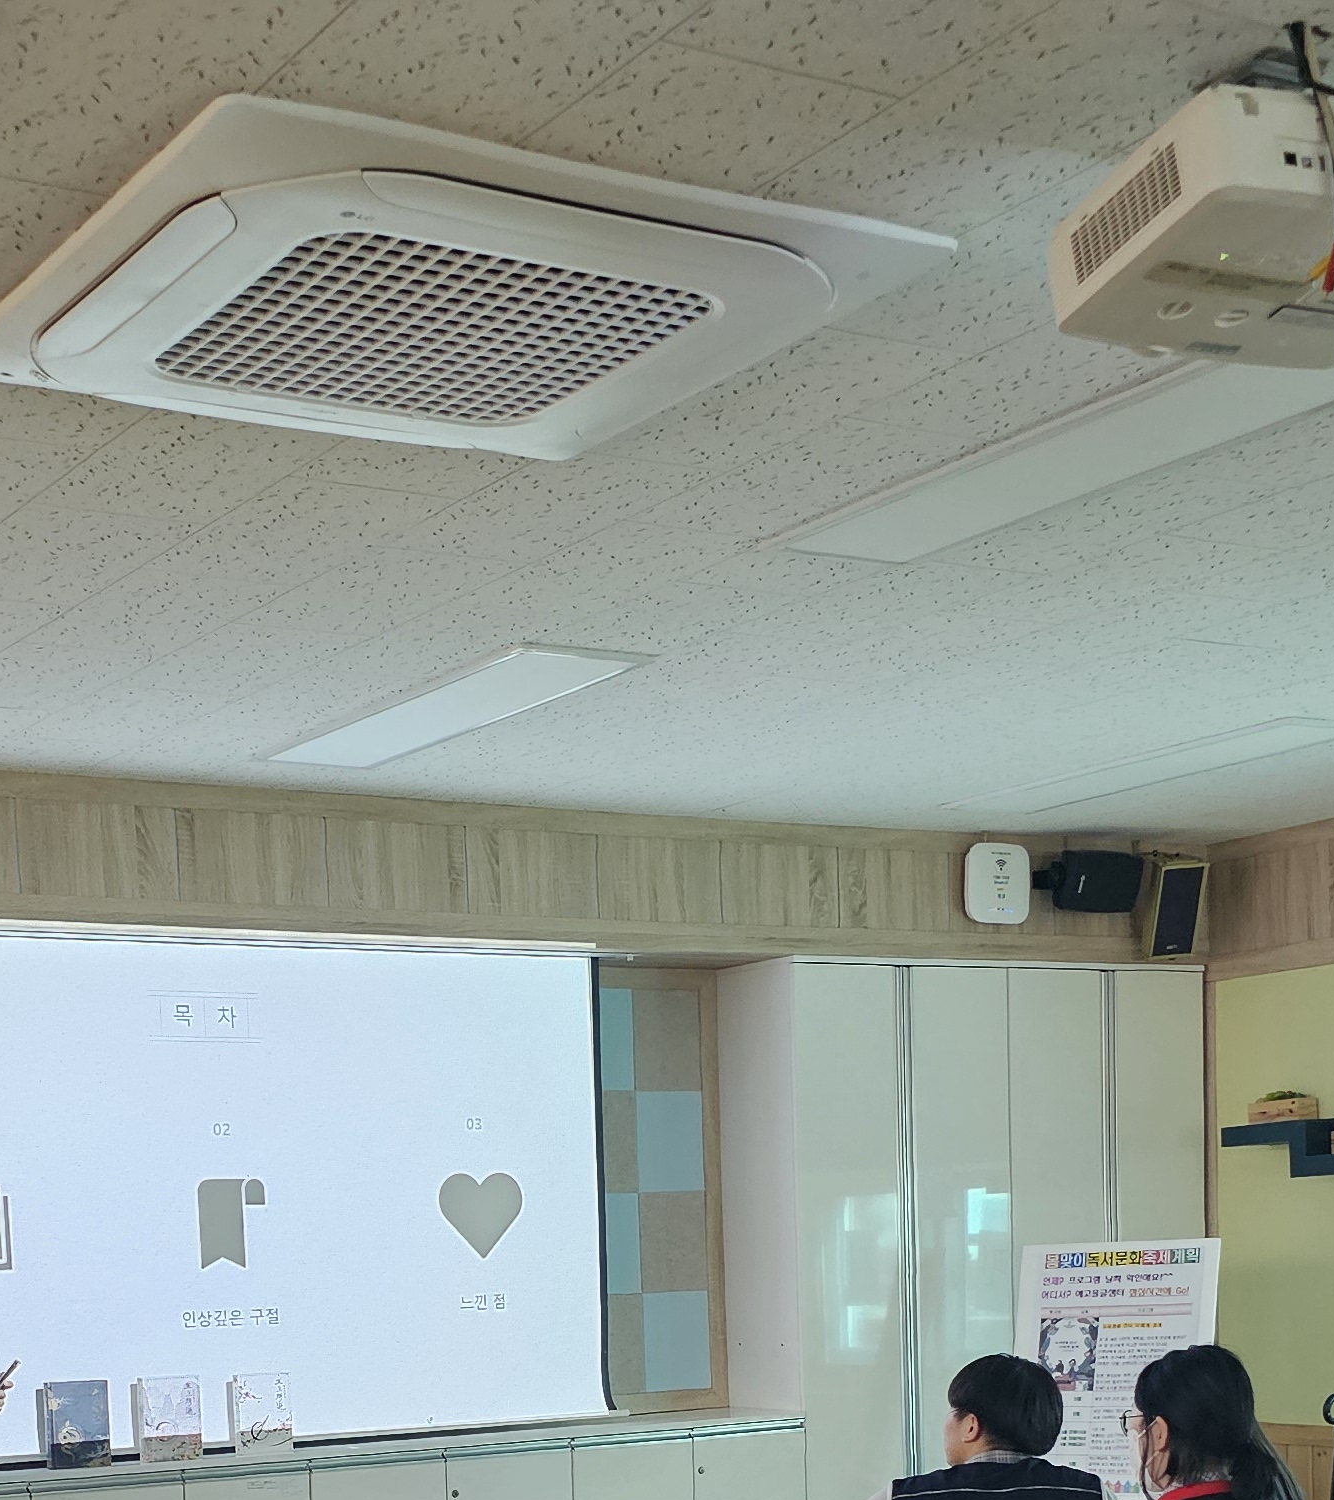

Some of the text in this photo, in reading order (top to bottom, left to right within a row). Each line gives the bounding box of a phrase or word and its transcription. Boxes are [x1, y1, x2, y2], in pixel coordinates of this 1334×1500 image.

[213, 1122, 231, 1136] 02
[466, 1117, 482, 1131] 03
[1068, 1275, 1101, 1285] 프로그램
[1041, 1289, 1072, 1299] 어디서?
[460, 1292, 507, 1312] 느낀 점
[181, 1305, 280, 1328] 인상깊은 구절
